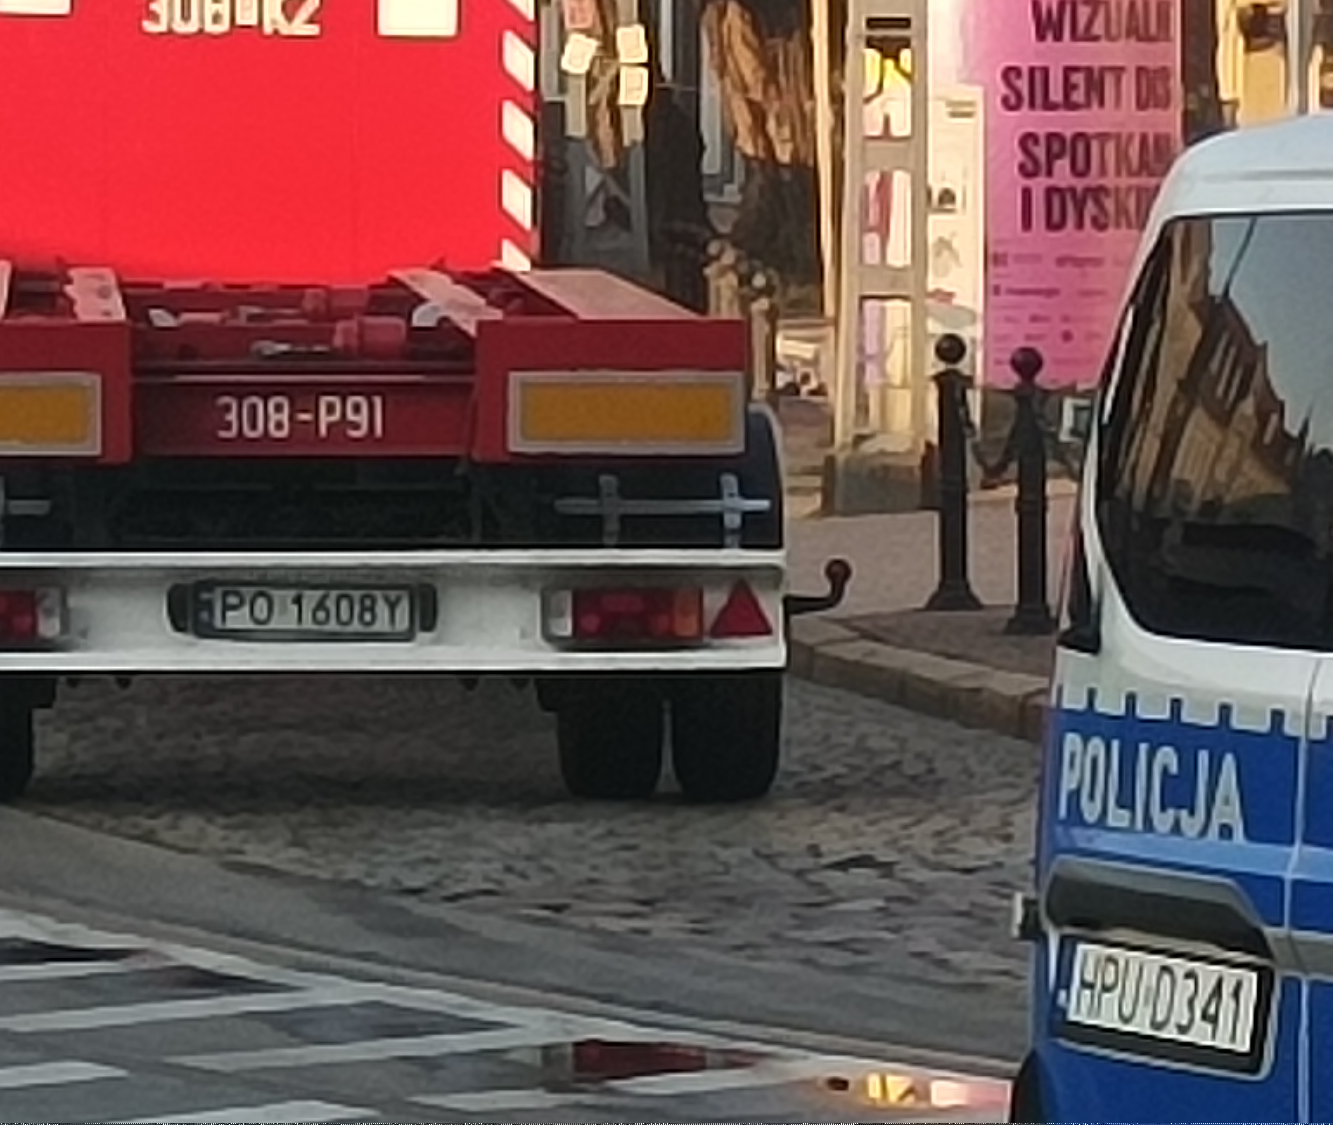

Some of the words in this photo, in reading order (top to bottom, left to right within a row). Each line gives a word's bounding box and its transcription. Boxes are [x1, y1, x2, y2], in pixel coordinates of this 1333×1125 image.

[1000, 65, 1126, 112] SILENT
[1020, 186, 1032, 233] I
[215, 395, 383, 439] 308-P91
[221, 589, 274, 626] PO
[290, 591, 402, 629] 1608Y
[1059, 731, 1246, 842] POLICJA
[1076, 951, 1145, 1025] HPU
[1149, 963, 1243, 1044] D341
